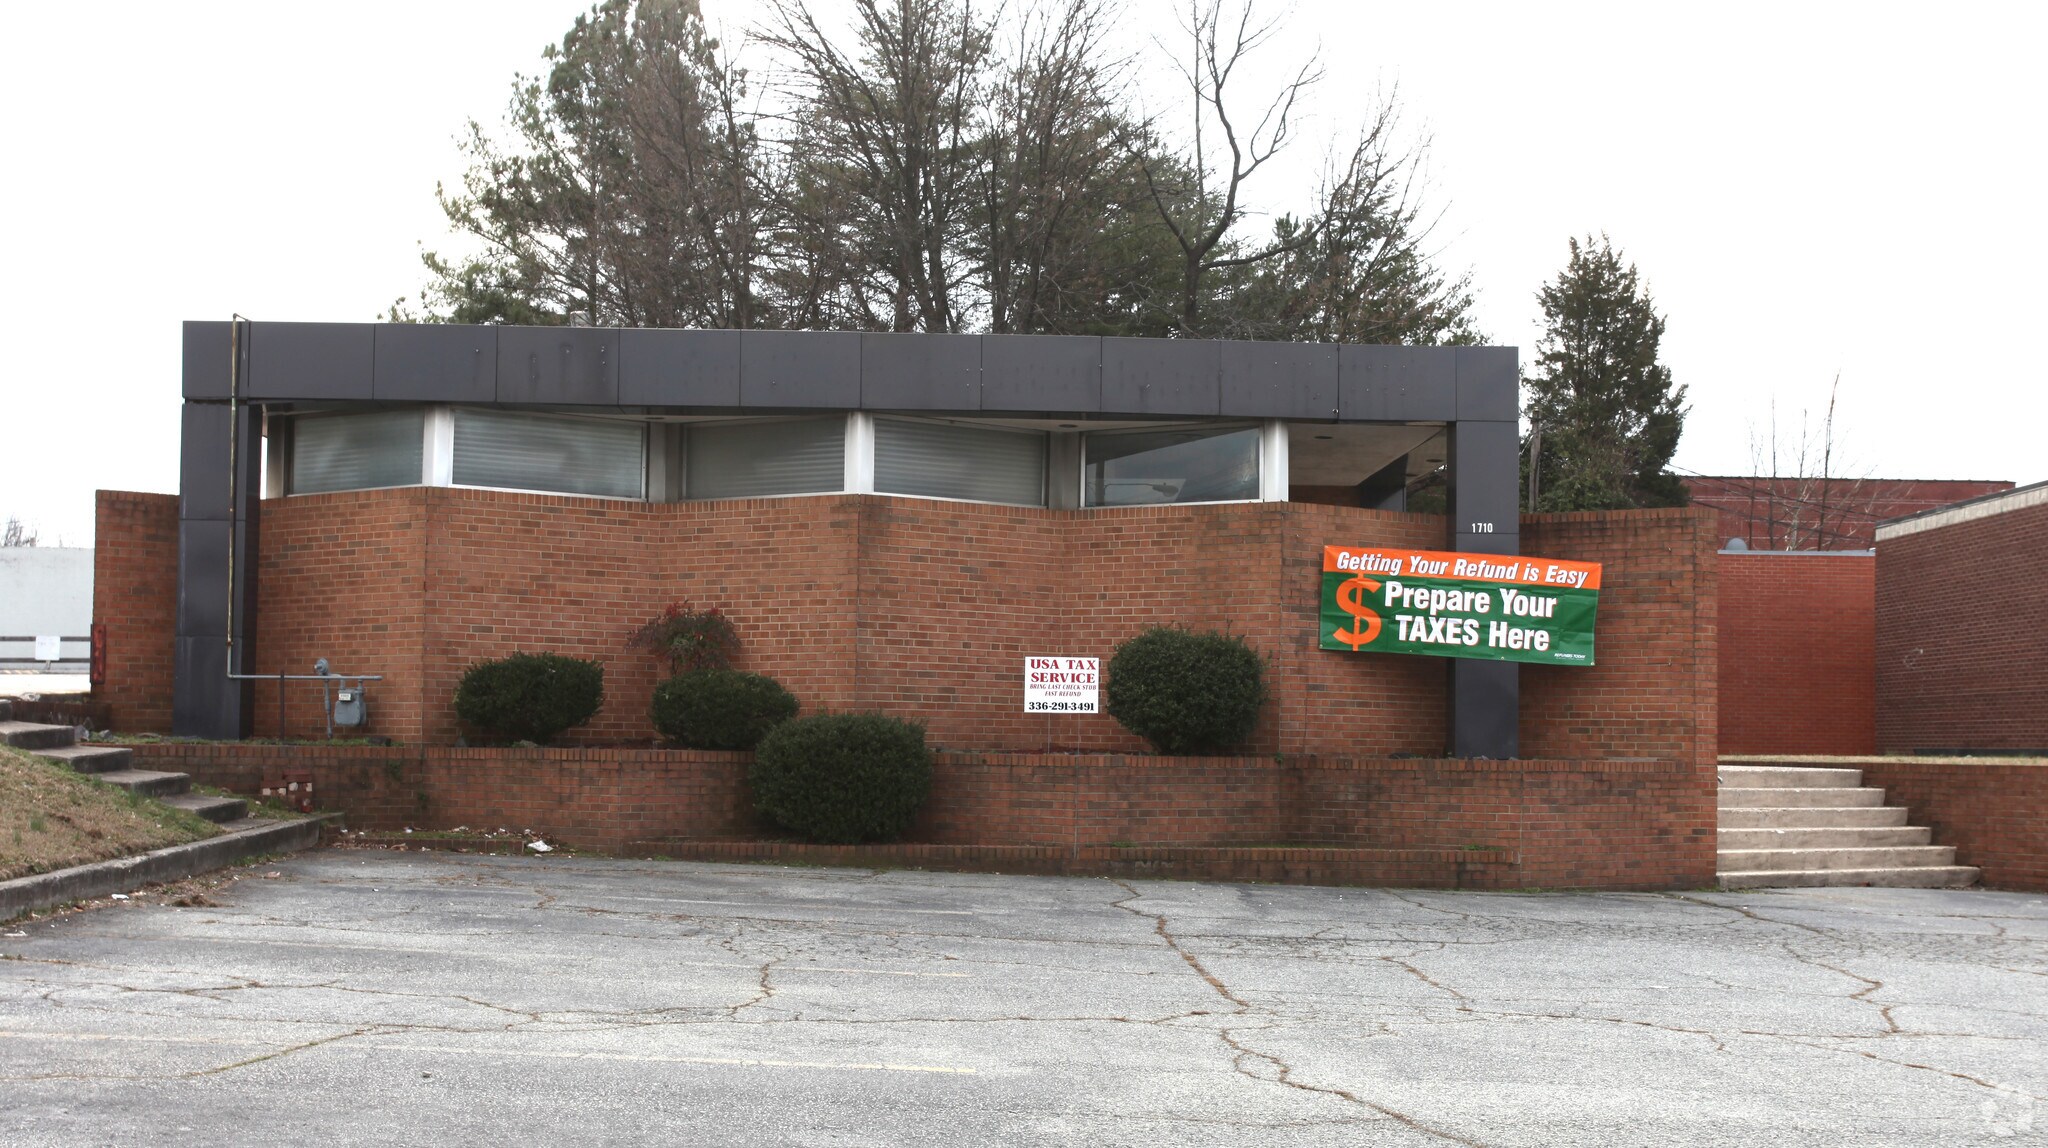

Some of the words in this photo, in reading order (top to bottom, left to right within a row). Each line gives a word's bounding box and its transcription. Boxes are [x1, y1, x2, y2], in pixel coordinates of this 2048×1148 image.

[1472, 522, 1493, 533] 1710
[1336, 551, 1403, 576] Getting
[1409, 555, 1449, 575] Your
[1453, 558, 1519, 580] Refund
[1522, 563, 1540, 581] is
[1544, 565, 1588, 589] Easy
[1384, 580, 1491, 615] Prepare
[1499, 587, 1557, 618] Your
[1395, 614, 1480, 646] TAXES
[1488, 620, 1550, 651] Here
[1030, 658, 1060, 670] USA
[1066, 659, 1097, 671] TAX
[1030, 671, 1096, 684] SERVICE
[1028, 701, 1095, 711] 336-291-3491
